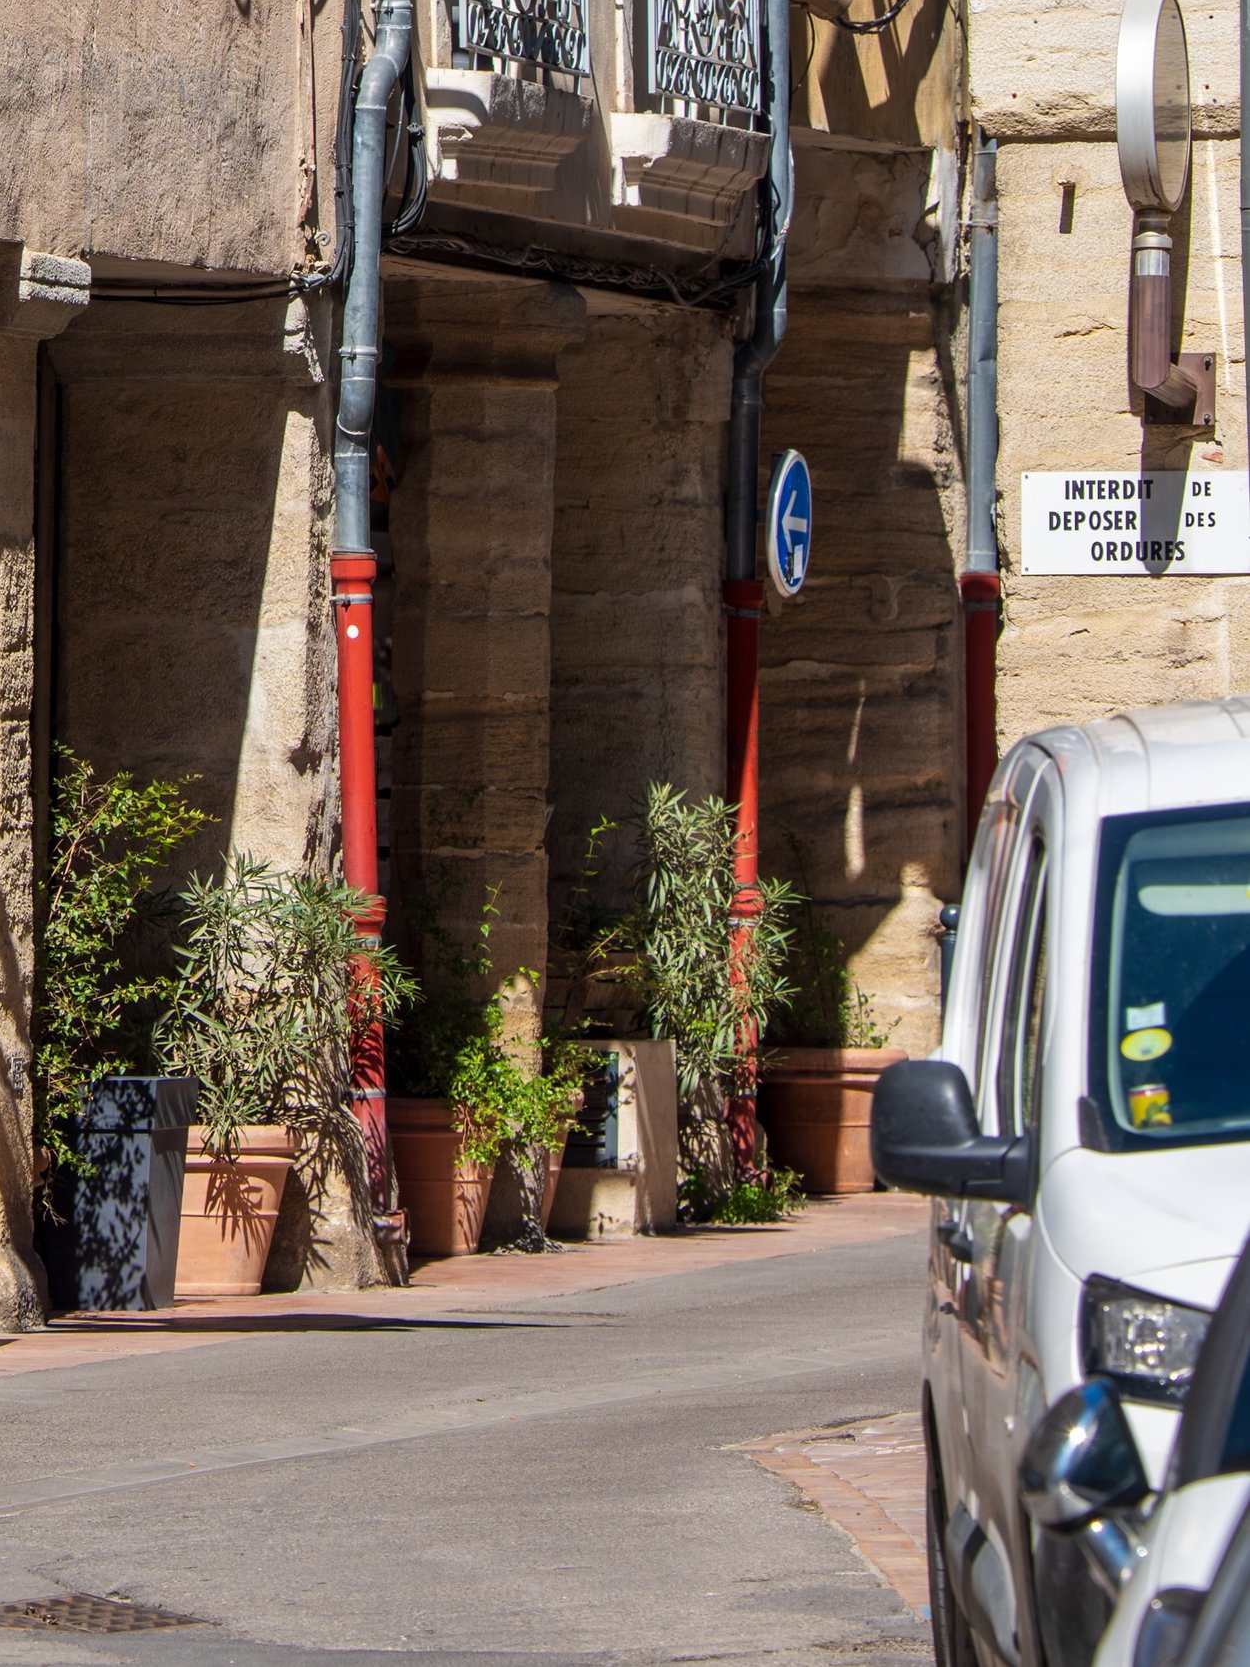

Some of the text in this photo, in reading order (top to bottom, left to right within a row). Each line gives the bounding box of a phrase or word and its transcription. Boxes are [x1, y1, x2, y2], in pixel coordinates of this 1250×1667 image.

[1064, 479, 1212, 500] INTERDIT DE
[1048, 510, 1216, 531] DEPOSER DES
[1090, 540, 1186, 562] ORDURES
